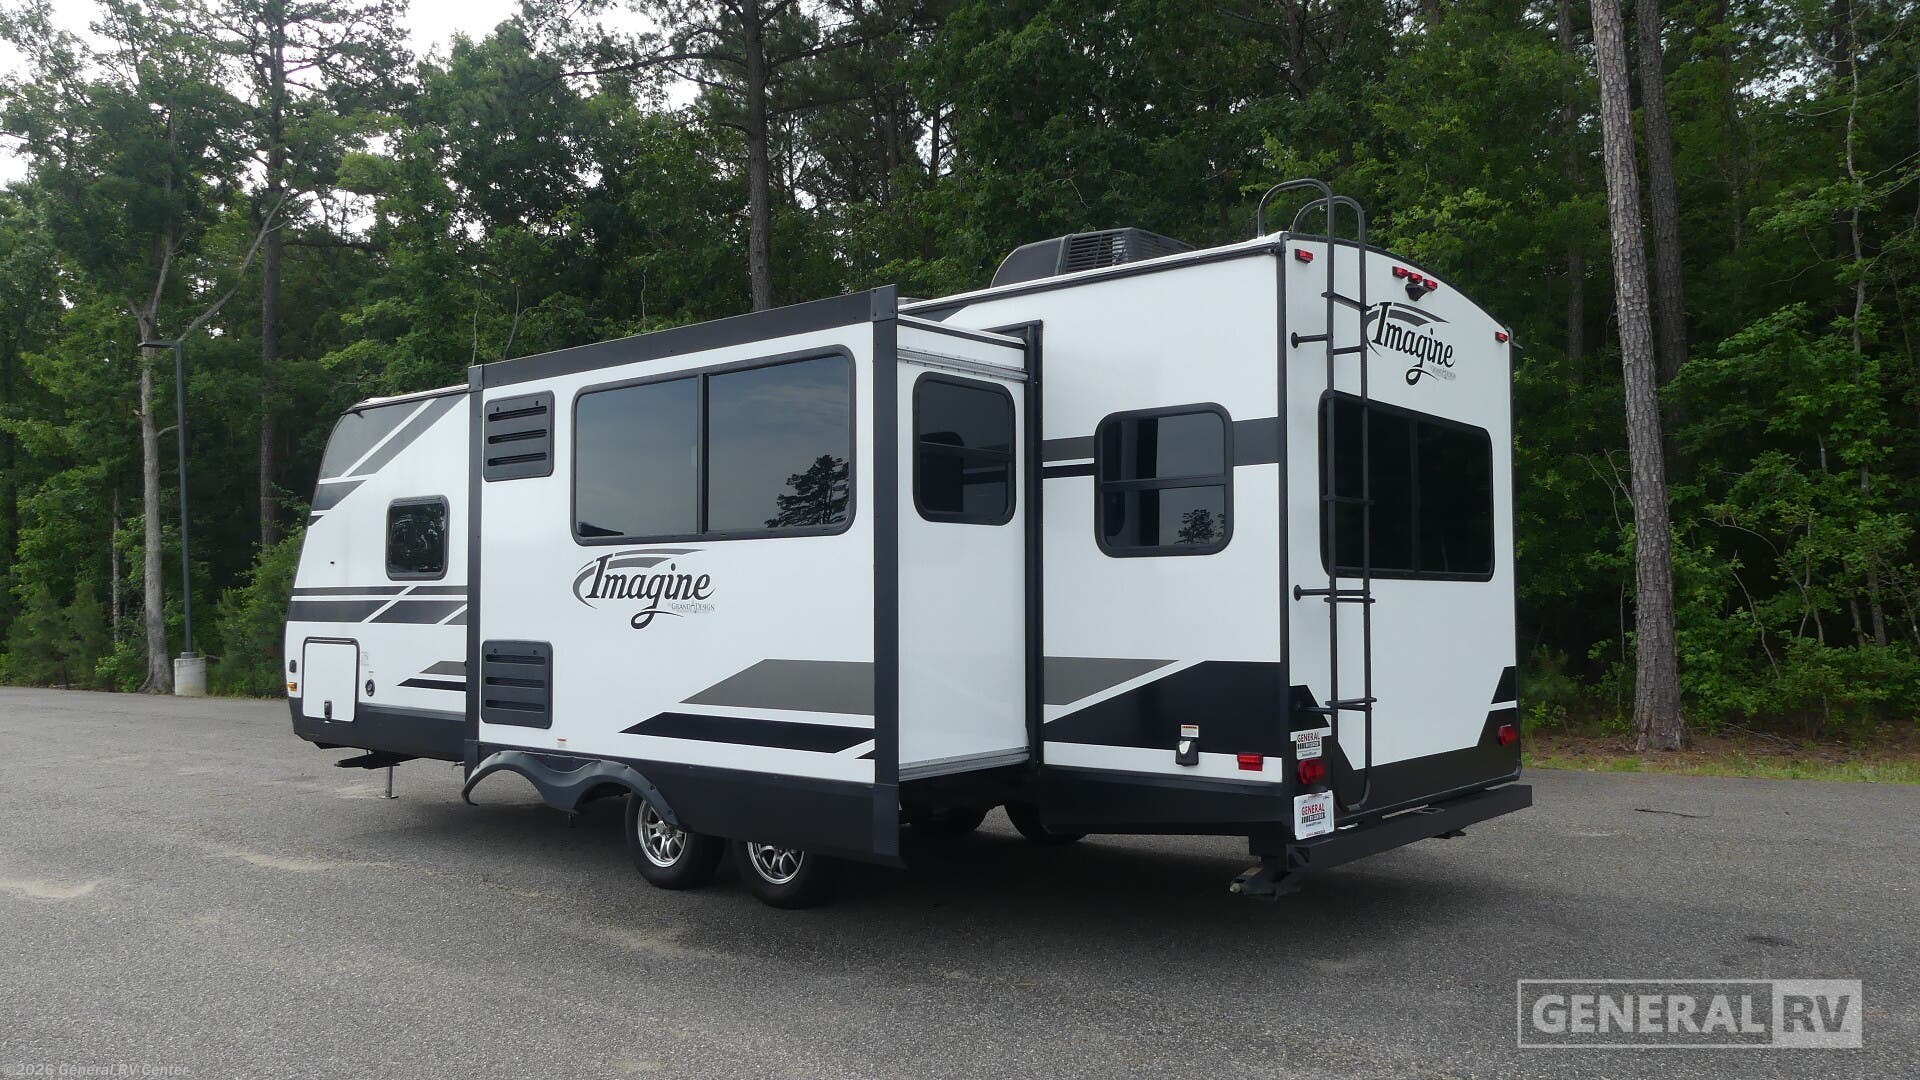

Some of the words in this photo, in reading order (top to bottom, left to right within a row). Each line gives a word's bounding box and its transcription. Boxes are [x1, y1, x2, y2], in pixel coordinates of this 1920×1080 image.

[1371, 302, 1456, 385] Imagine
[585, 553, 717, 629] Imagine
[1297, 731, 1320, 743] GENERAL
[1301, 803, 1325, 816] GENERAL
